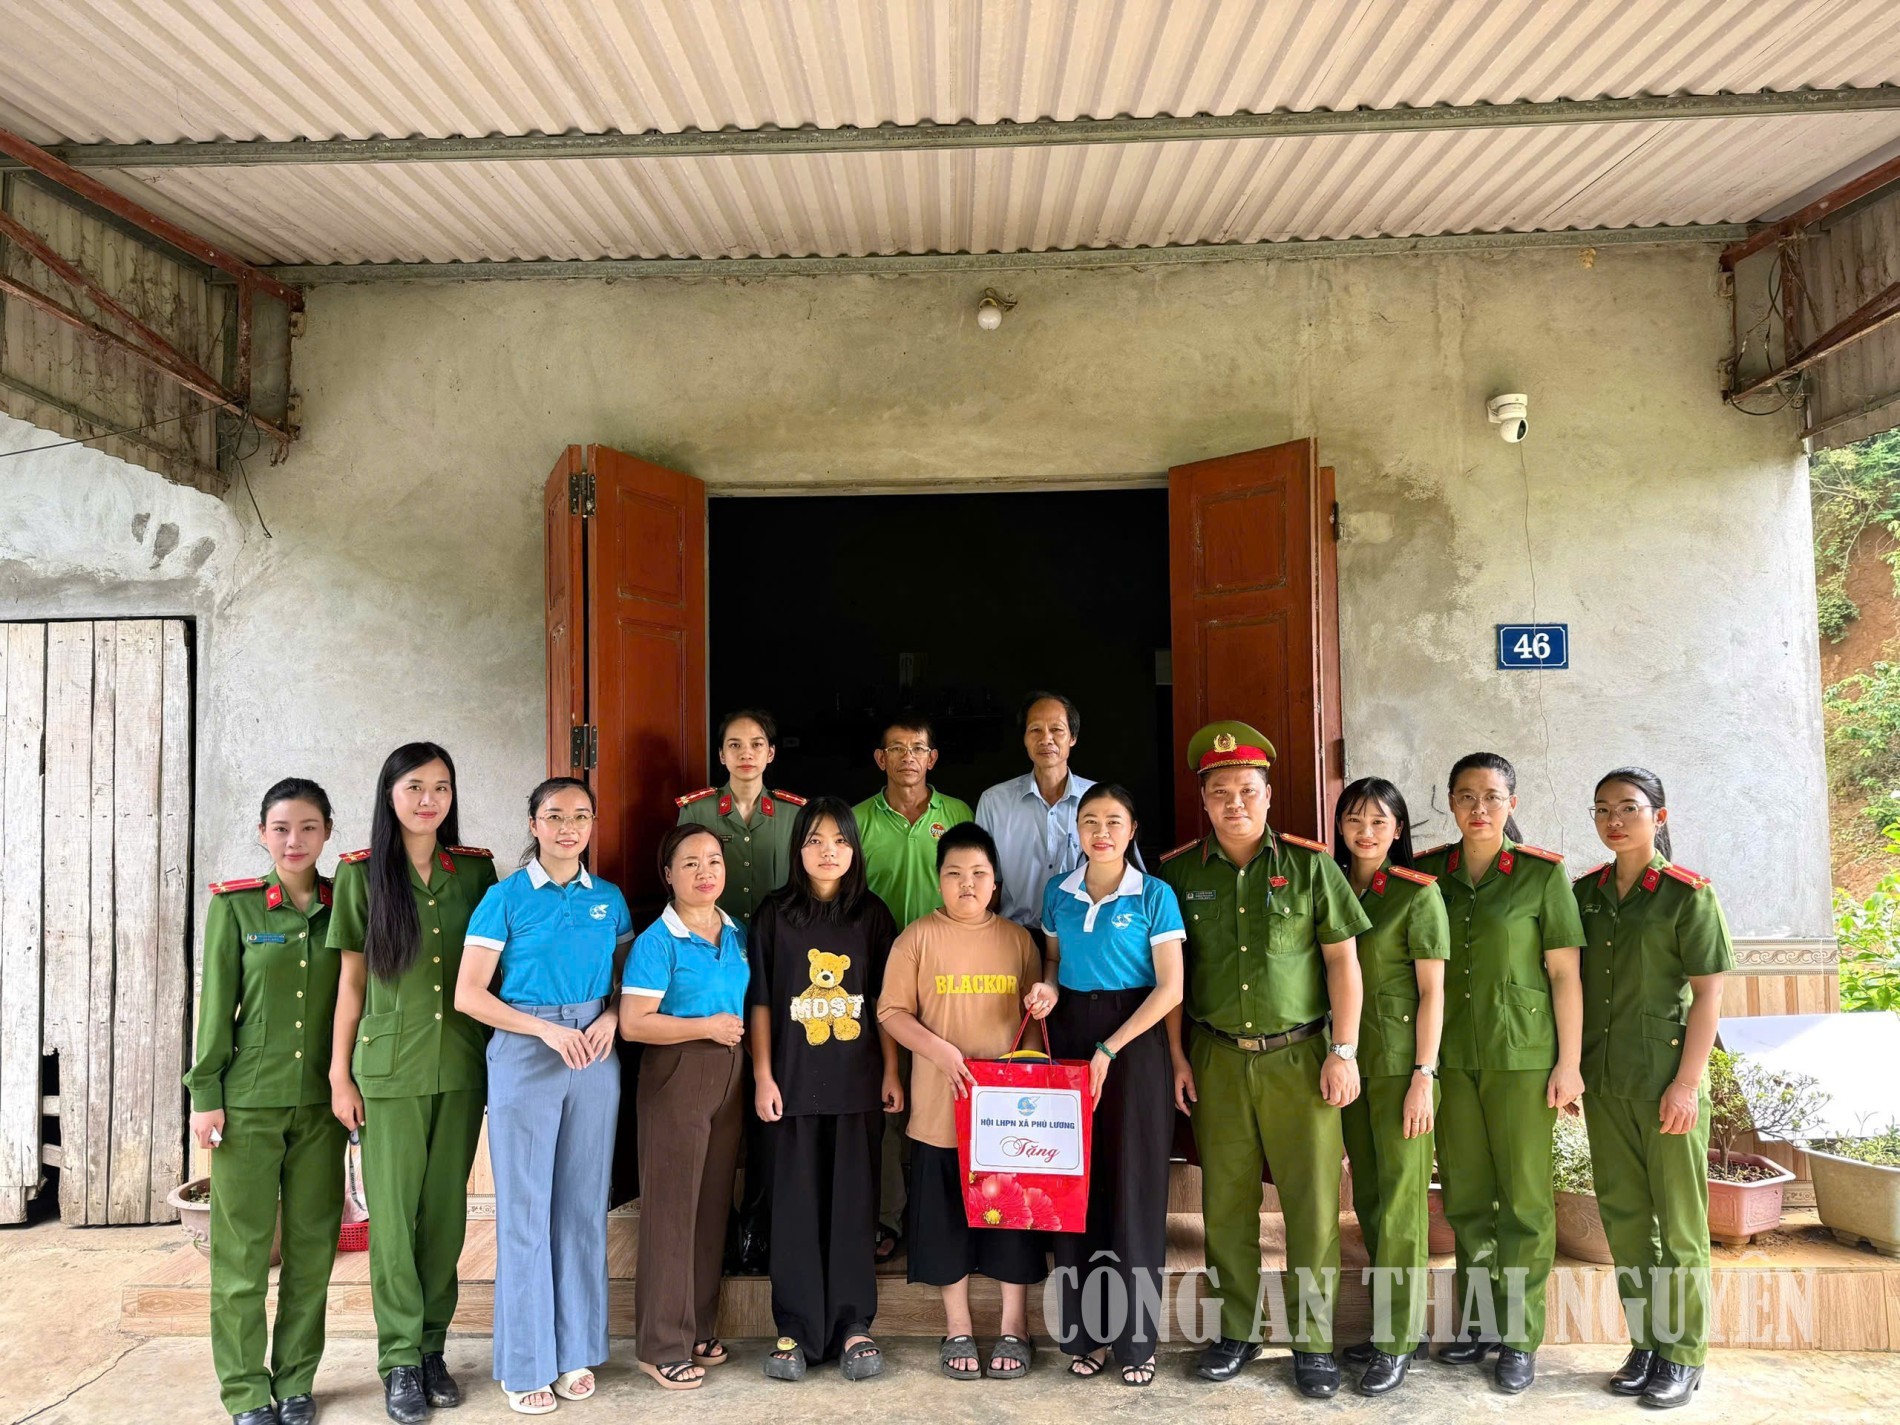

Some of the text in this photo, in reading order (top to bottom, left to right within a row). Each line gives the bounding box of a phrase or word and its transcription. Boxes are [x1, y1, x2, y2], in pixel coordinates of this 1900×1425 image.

[1513, 632, 1551, 659] 46
[790, 993, 865, 1022] MOST
[980, 1118, 994, 1127] HỘI
[995, 1119, 1016, 1127] LHPN
[1049, 1121, 1075, 1129] LƯƠNG
[1000, 1136, 1061, 1163] Tặng
